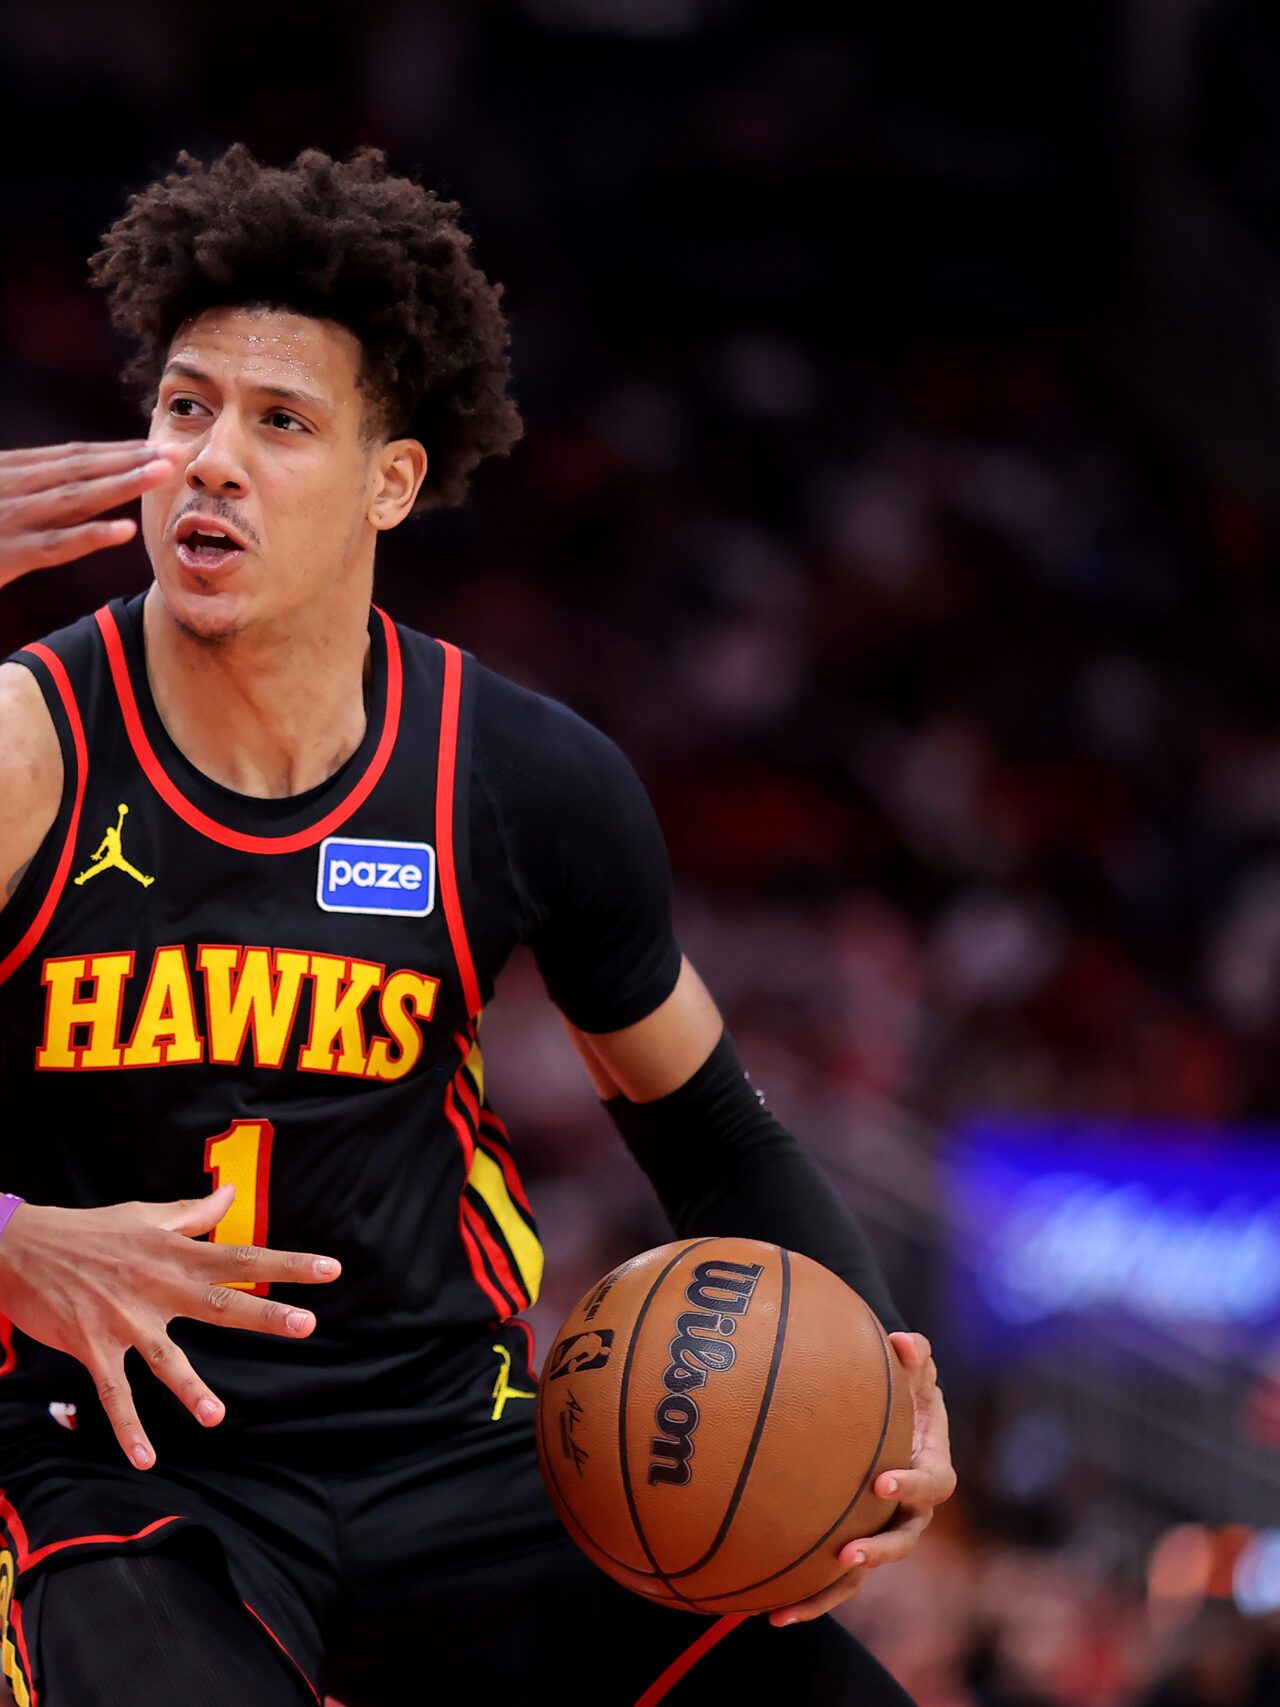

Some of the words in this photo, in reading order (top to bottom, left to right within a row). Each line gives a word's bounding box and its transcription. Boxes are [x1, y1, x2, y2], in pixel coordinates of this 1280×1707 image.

[328, 858, 423, 892] paze
[34, 943, 441, 1083] HAWKS
[204, 1118, 275, 1297] 1
[649, 1259, 764, 1486] Wilson
